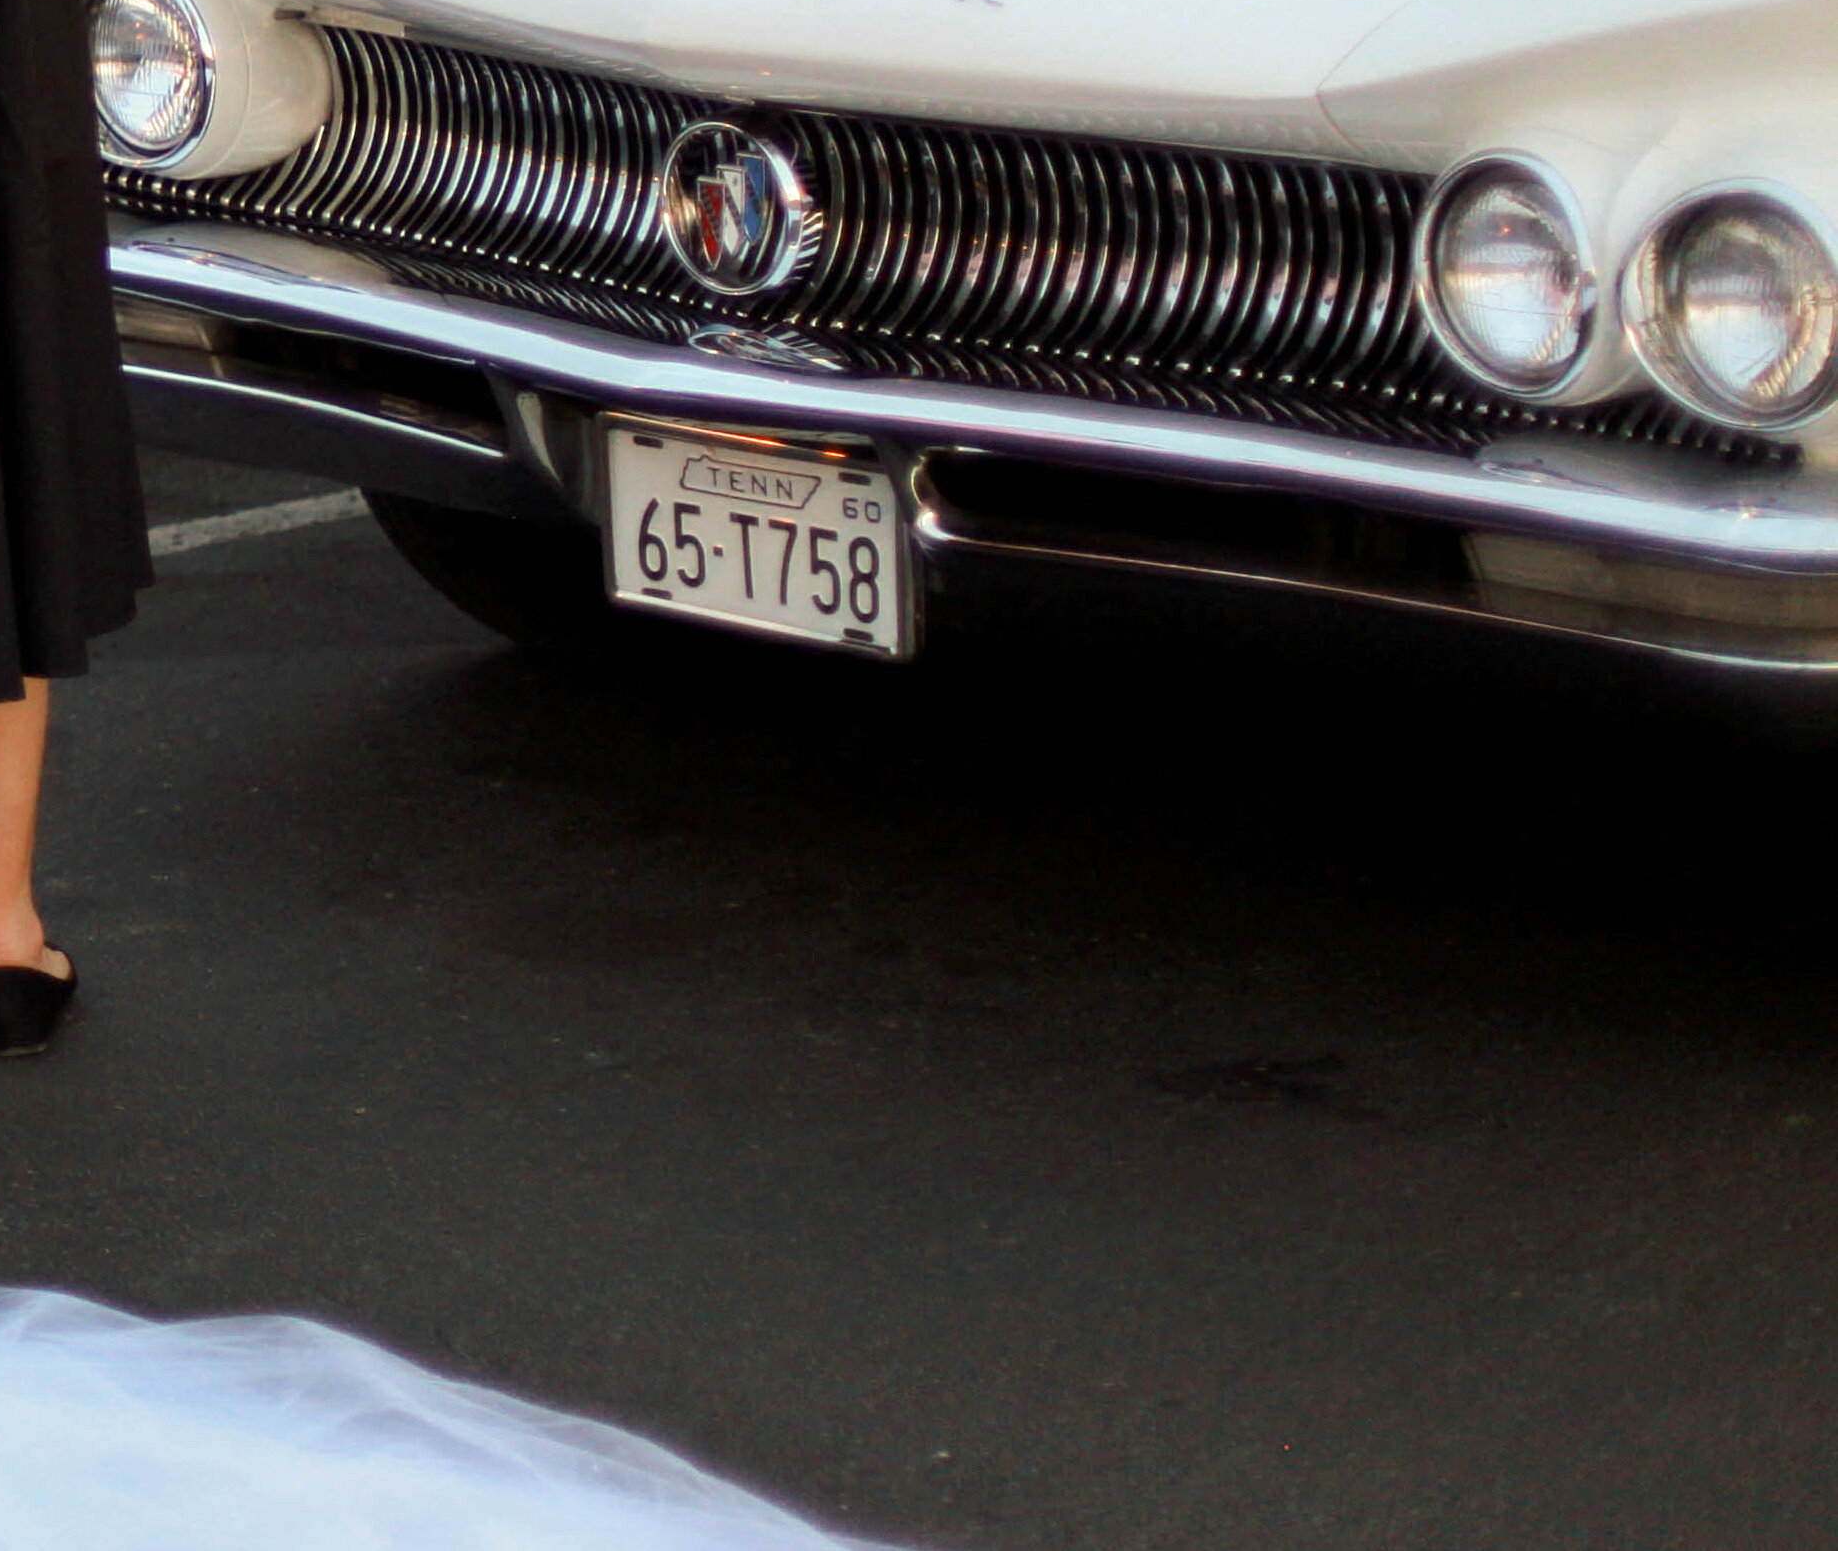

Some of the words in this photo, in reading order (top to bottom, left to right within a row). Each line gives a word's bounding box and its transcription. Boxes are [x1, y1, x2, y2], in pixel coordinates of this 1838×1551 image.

[706, 466, 795, 501] TENN
[842, 496, 882, 524] 60
[637, 497, 881, 624] 65-T758
